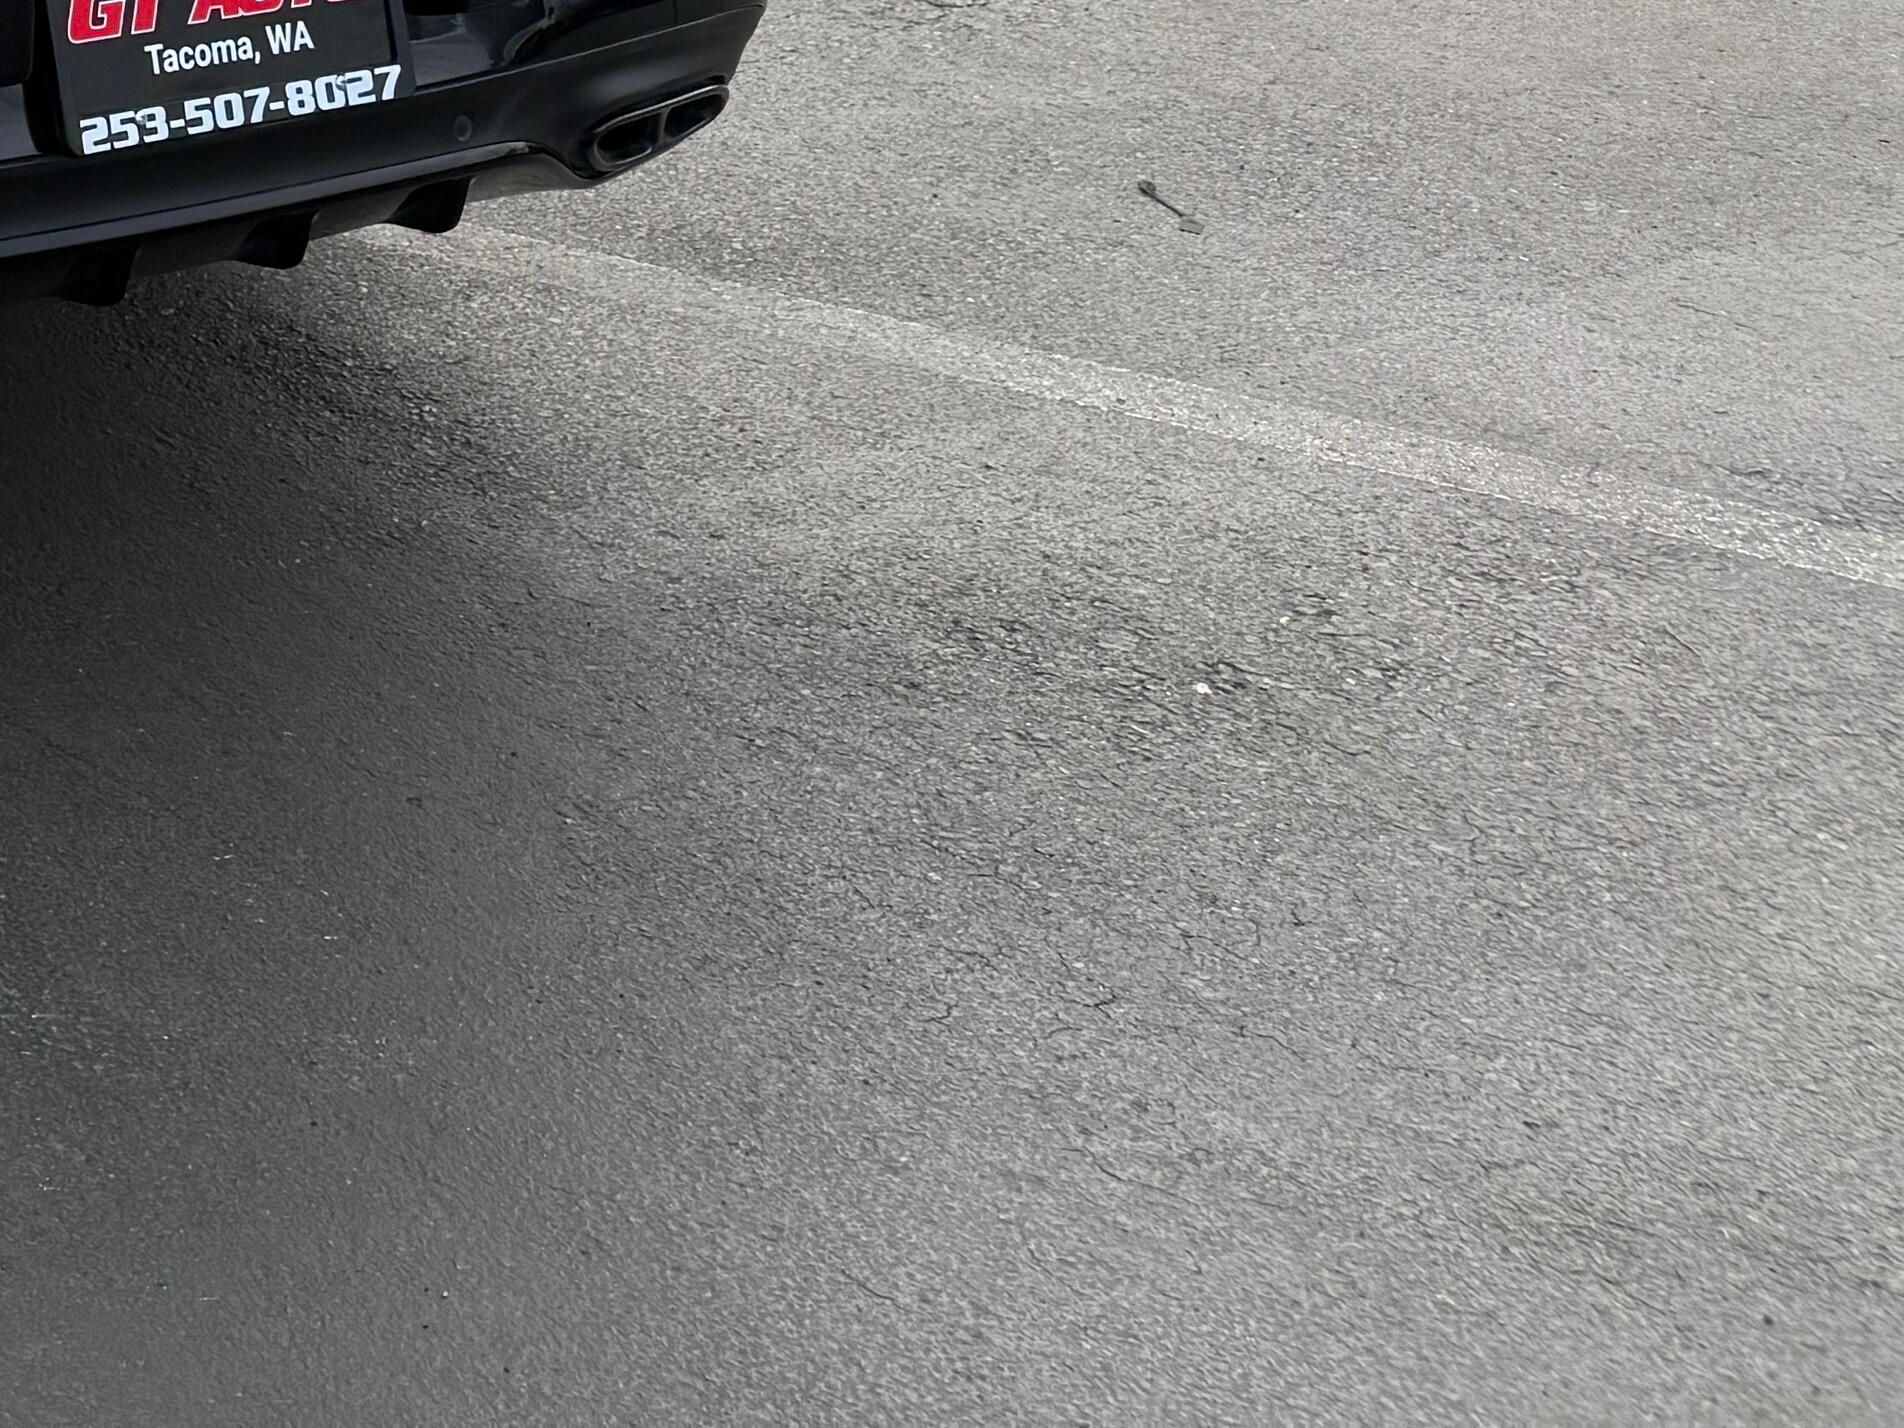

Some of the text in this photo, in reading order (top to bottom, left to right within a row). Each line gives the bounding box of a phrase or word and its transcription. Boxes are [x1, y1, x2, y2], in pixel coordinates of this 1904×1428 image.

[143, 20, 315, 75] Tacoma, WA
[79, 64, 402, 155] 253-507-8027
